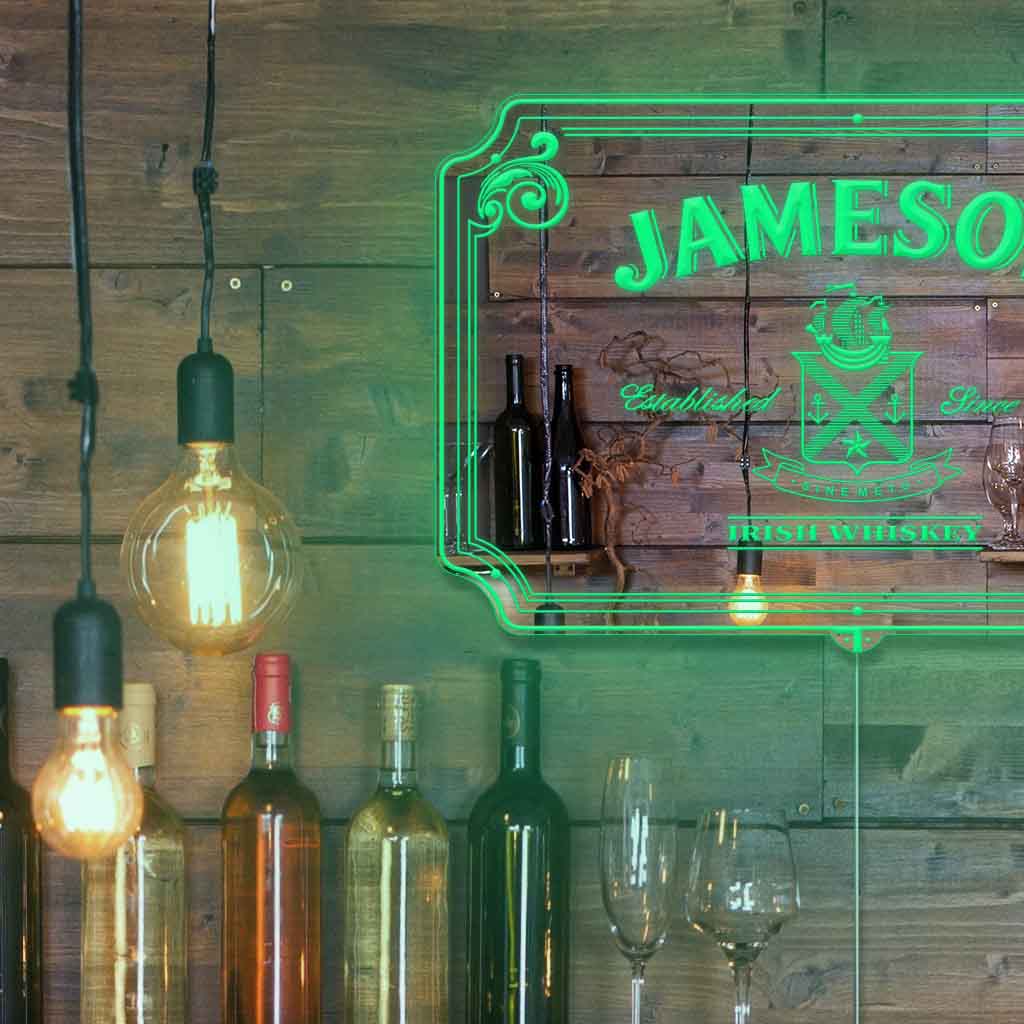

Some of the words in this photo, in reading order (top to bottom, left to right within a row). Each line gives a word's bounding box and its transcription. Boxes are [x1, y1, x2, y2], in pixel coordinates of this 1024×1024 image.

[620, 383, 783, 414] Established
[940, 385, 1021, 416] Since
[728, 524, 818, 542] IRISH
[829, 524, 984, 542] WHISKEY
